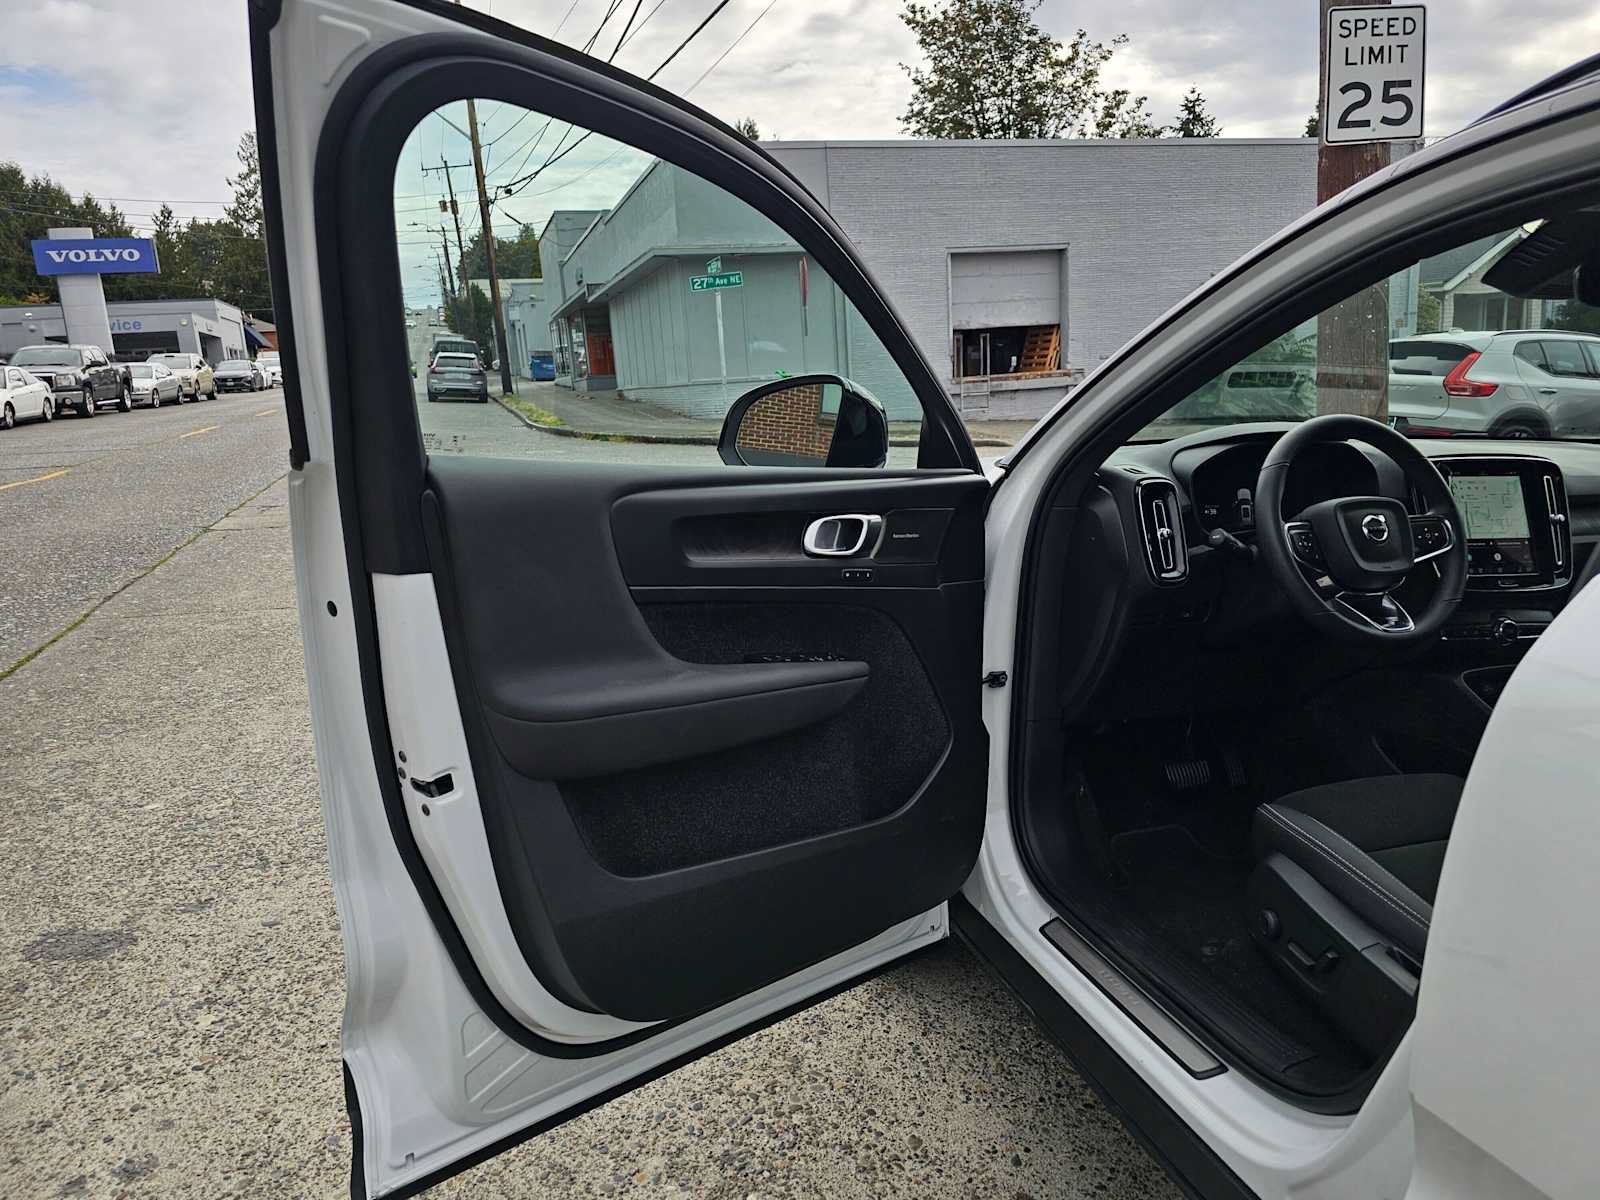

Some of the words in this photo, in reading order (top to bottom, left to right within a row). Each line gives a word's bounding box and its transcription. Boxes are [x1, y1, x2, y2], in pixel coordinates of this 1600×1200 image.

[1339, 16, 1417, 39] SPEED
[1345, 44, 1408, 66] LIMIT
[1337, 79, 1414, 129] 25
[45, 248, 141, 263] VOLVO
[715, 277, 728, 287] Ave
[729, 275, 742, 284] NE
